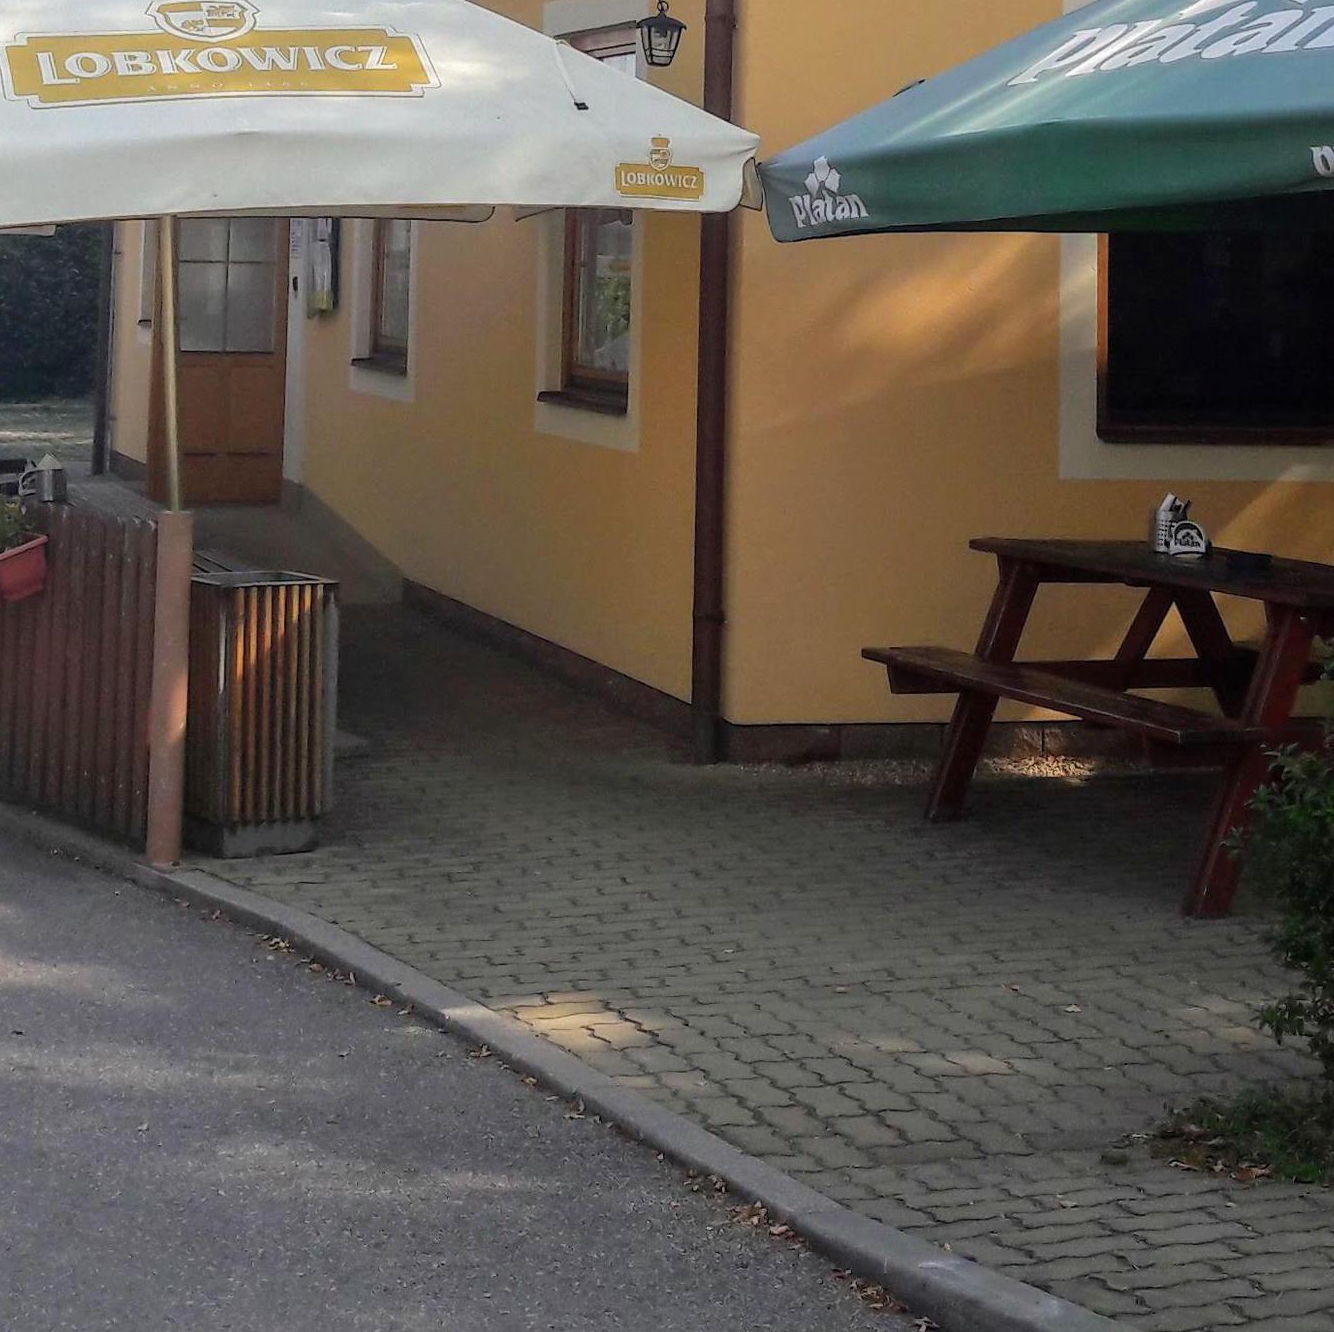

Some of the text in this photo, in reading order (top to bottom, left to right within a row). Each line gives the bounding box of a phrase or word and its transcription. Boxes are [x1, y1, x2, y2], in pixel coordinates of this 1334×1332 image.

[36, 44, 398, 86] LOBKOWICZ
[620, 169, 699, 190] LOBKOWICZ
[788, 189, 870, 229] Platan
